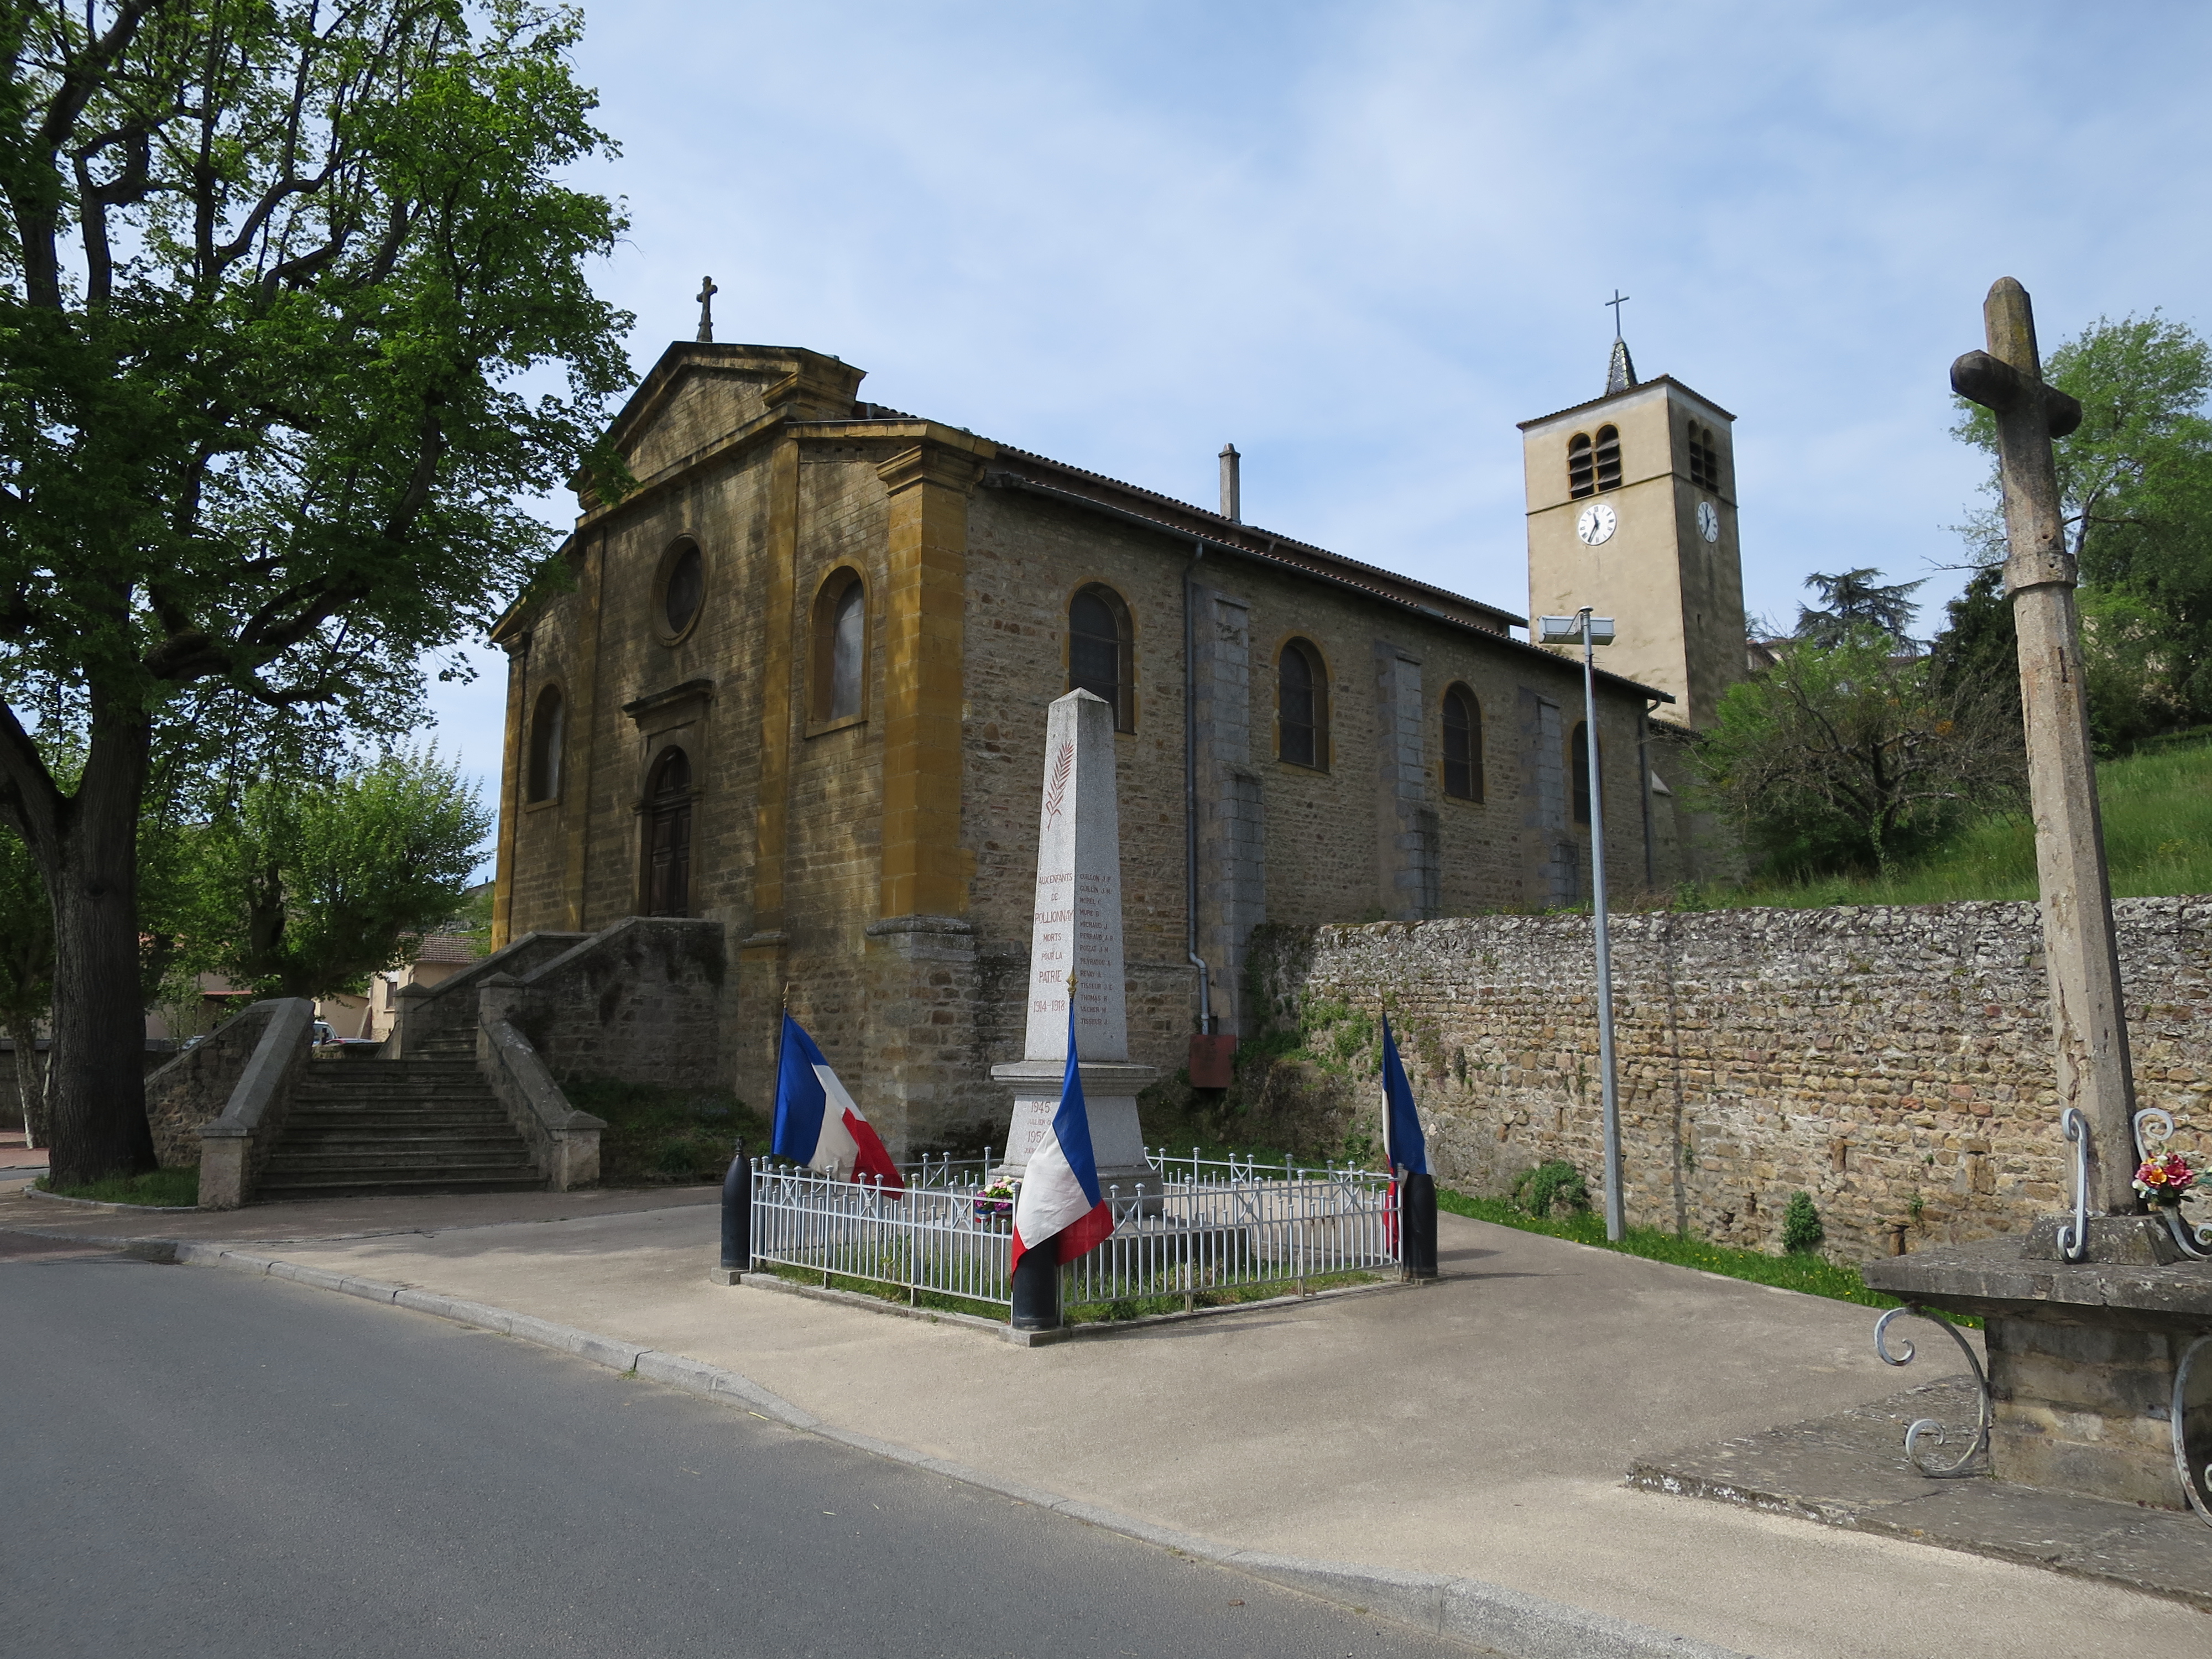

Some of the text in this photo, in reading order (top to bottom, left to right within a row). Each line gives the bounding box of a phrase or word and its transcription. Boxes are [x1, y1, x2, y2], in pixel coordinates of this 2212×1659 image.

[1039, 873, 1073, 885] AUX ENFANTS
[1051, 893, 1058, 901] DE
[1034, 909, 1074, 924] POLLIONNAY
[1043, 932, 1062, 942] MORTS
[1041, 952, 1054, 961] POUR
[1039, 970, 1062, 983] PATRIE
[1033, 1000, 1065, 1013] 1914-1918
[1031, 1101, 1051, 1113] 1945
